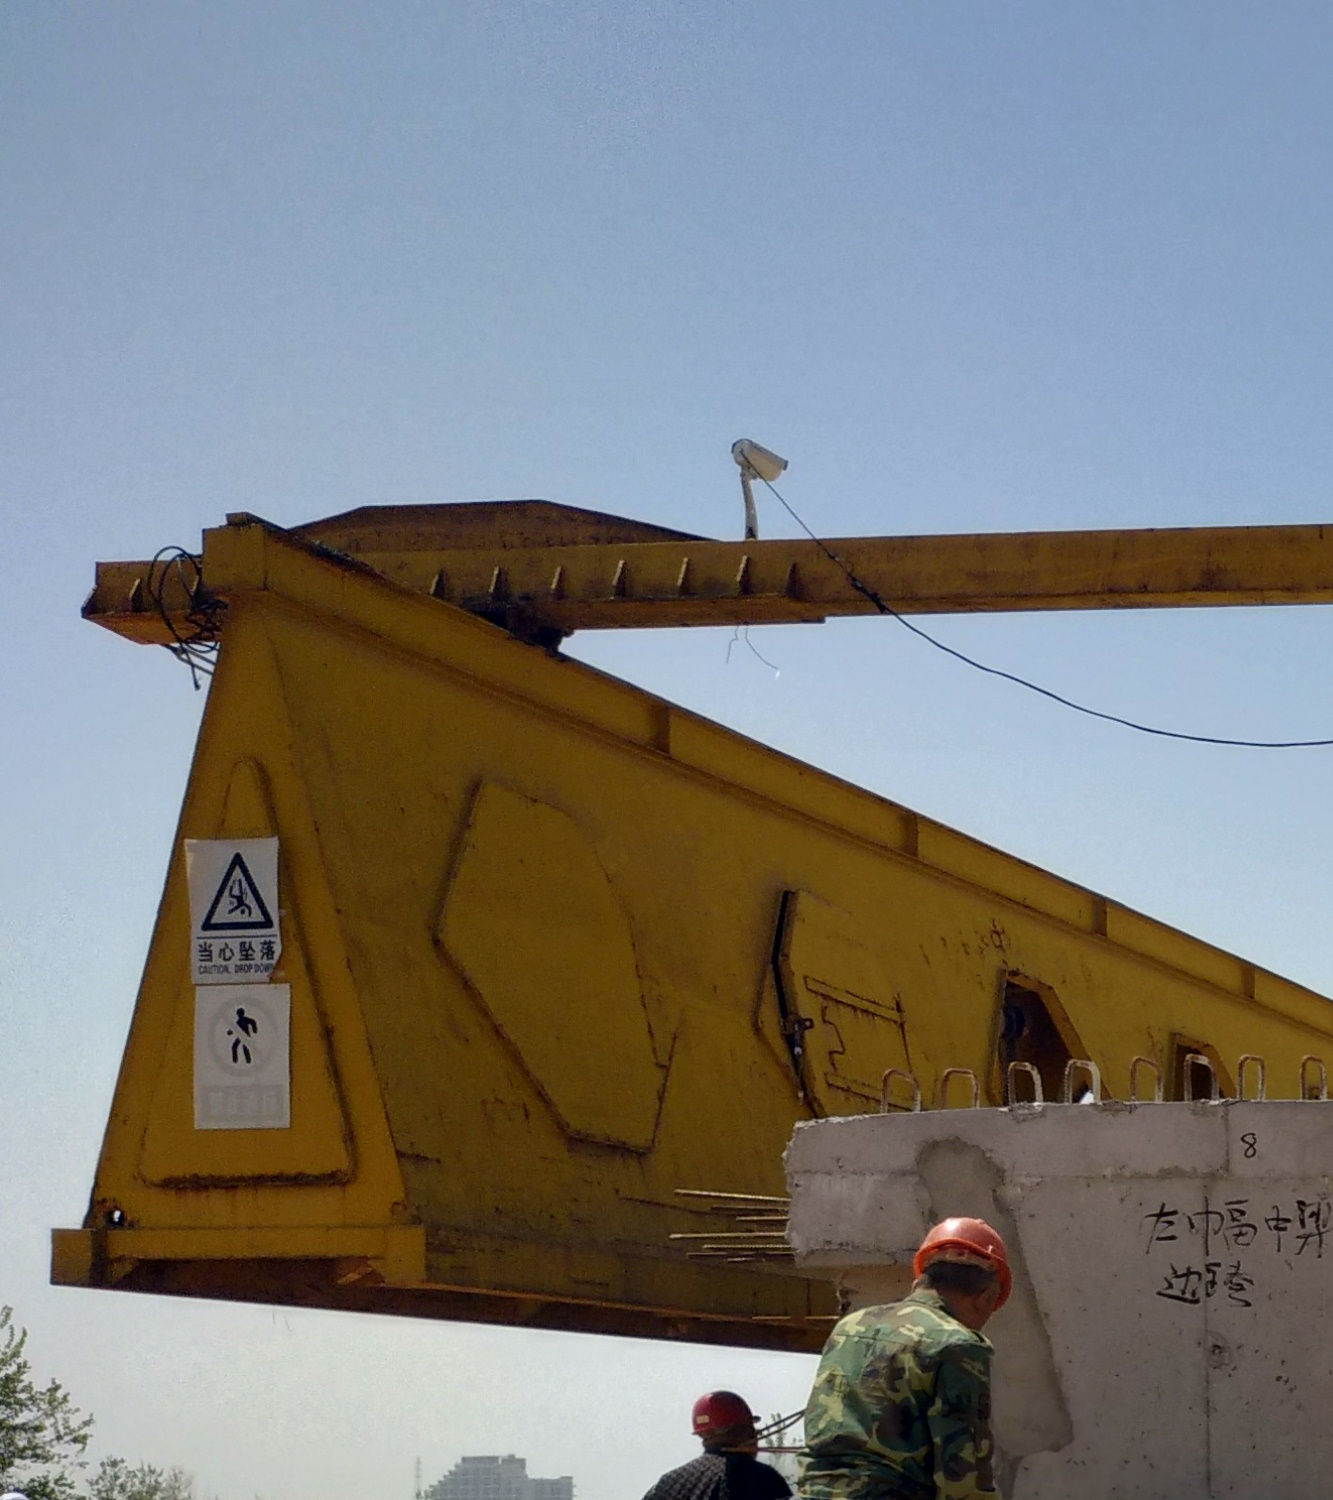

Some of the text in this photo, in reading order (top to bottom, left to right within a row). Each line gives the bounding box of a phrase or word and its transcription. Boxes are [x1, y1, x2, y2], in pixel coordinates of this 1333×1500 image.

[198, 939, 276, 962] 当心坠落
[234, 963, 253, 974] DROP
[1240, 1132, 1257, 1159] 8
